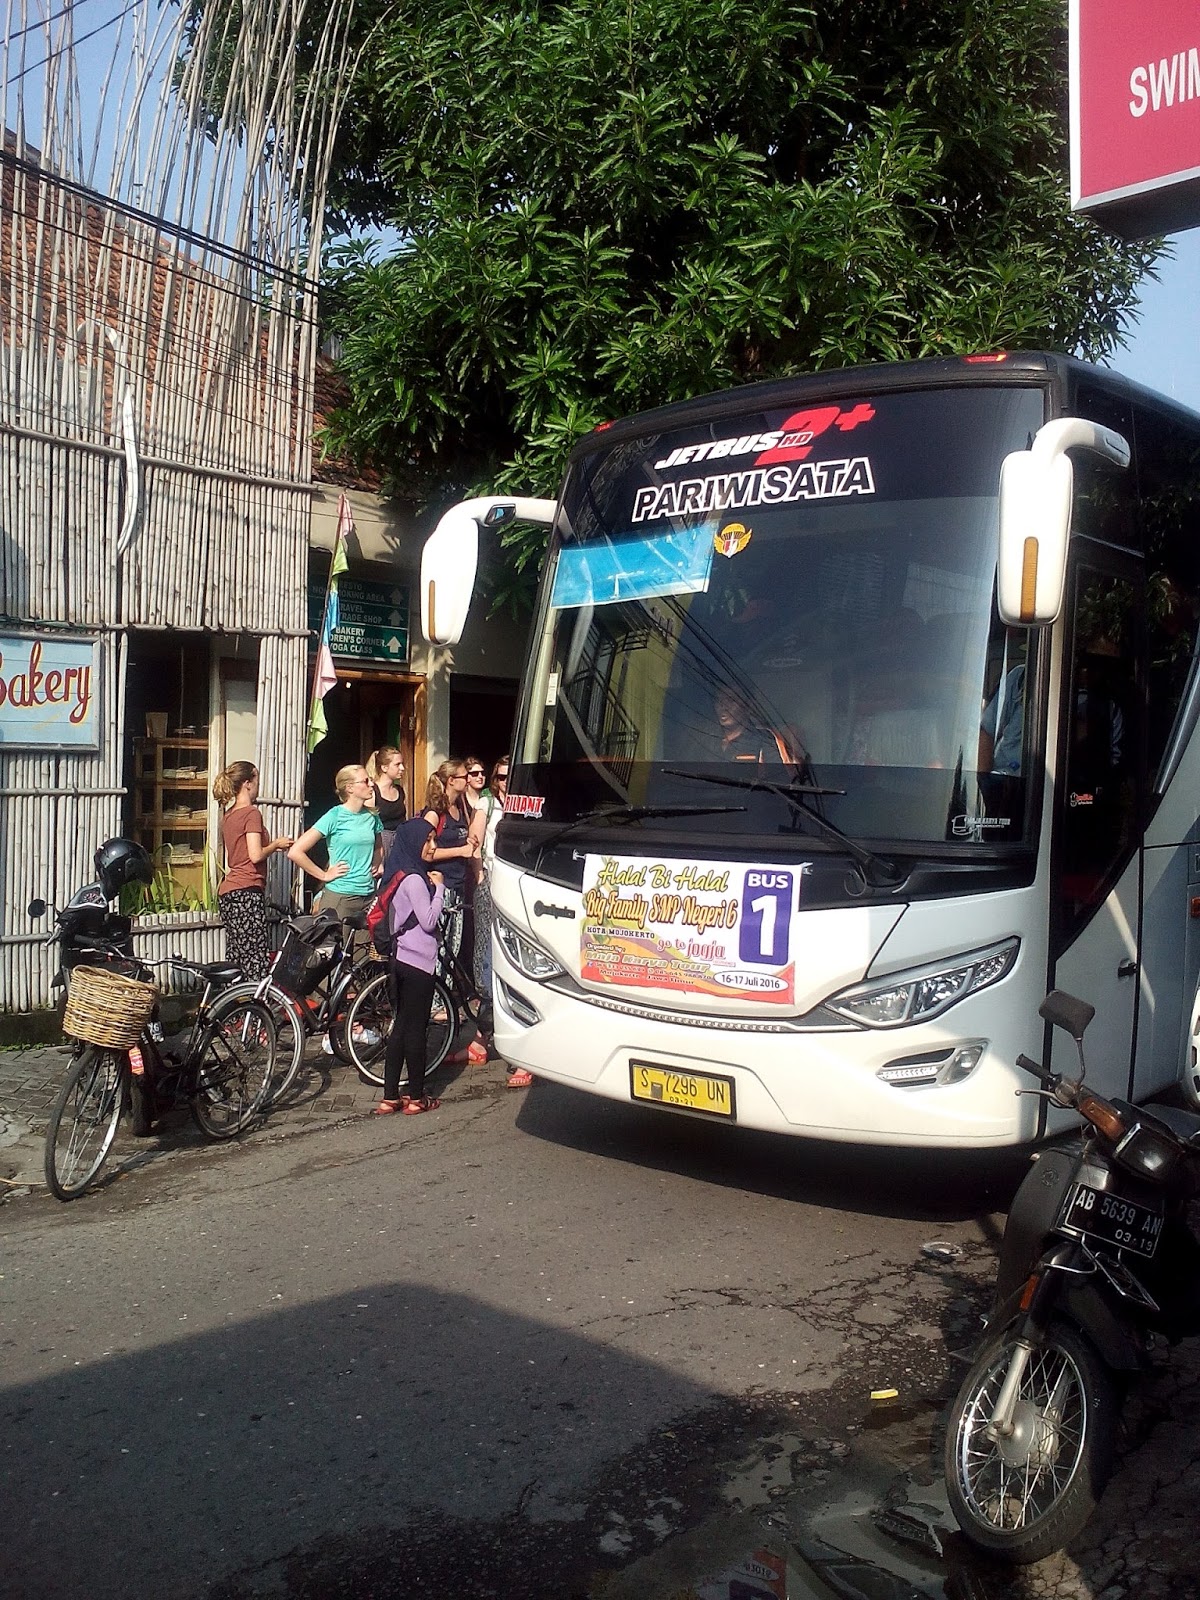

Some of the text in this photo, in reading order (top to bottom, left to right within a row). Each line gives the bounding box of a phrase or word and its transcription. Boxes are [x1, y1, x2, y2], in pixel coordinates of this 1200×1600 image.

[653, 430, 784, 470] JETBUS
[777, 431, 814, 449] HD
[631, 456, 876, 523] PARIWISATA
[363, 615, 383, 623] SHOP
[335, 626, 365, 636] BAKERY
[349, 645, 373, 654] CLASS
[598, 862, 730, 892] Halal Bi Halal
[747, 873, 789, 889] BUS
[586, 888, 738, 935] Big Family SMP Negeri 6
[587, 926, 655, 939] KOTA MOJOKERTO
[751, 895, 777, 956] 1
[657, 938, 726, 961] go to jogja
[585, 950, 621, 963] Maja
[622, 954, 669, 968] Karya
[670, 959, 711, 973] Tour
[721, 974, 780, 989] 16-17 Juli 2016
[641, 1067, 725, 1104] S 7296 UN
[1075, 1189, 1161, 1235] AB 5639 AN
